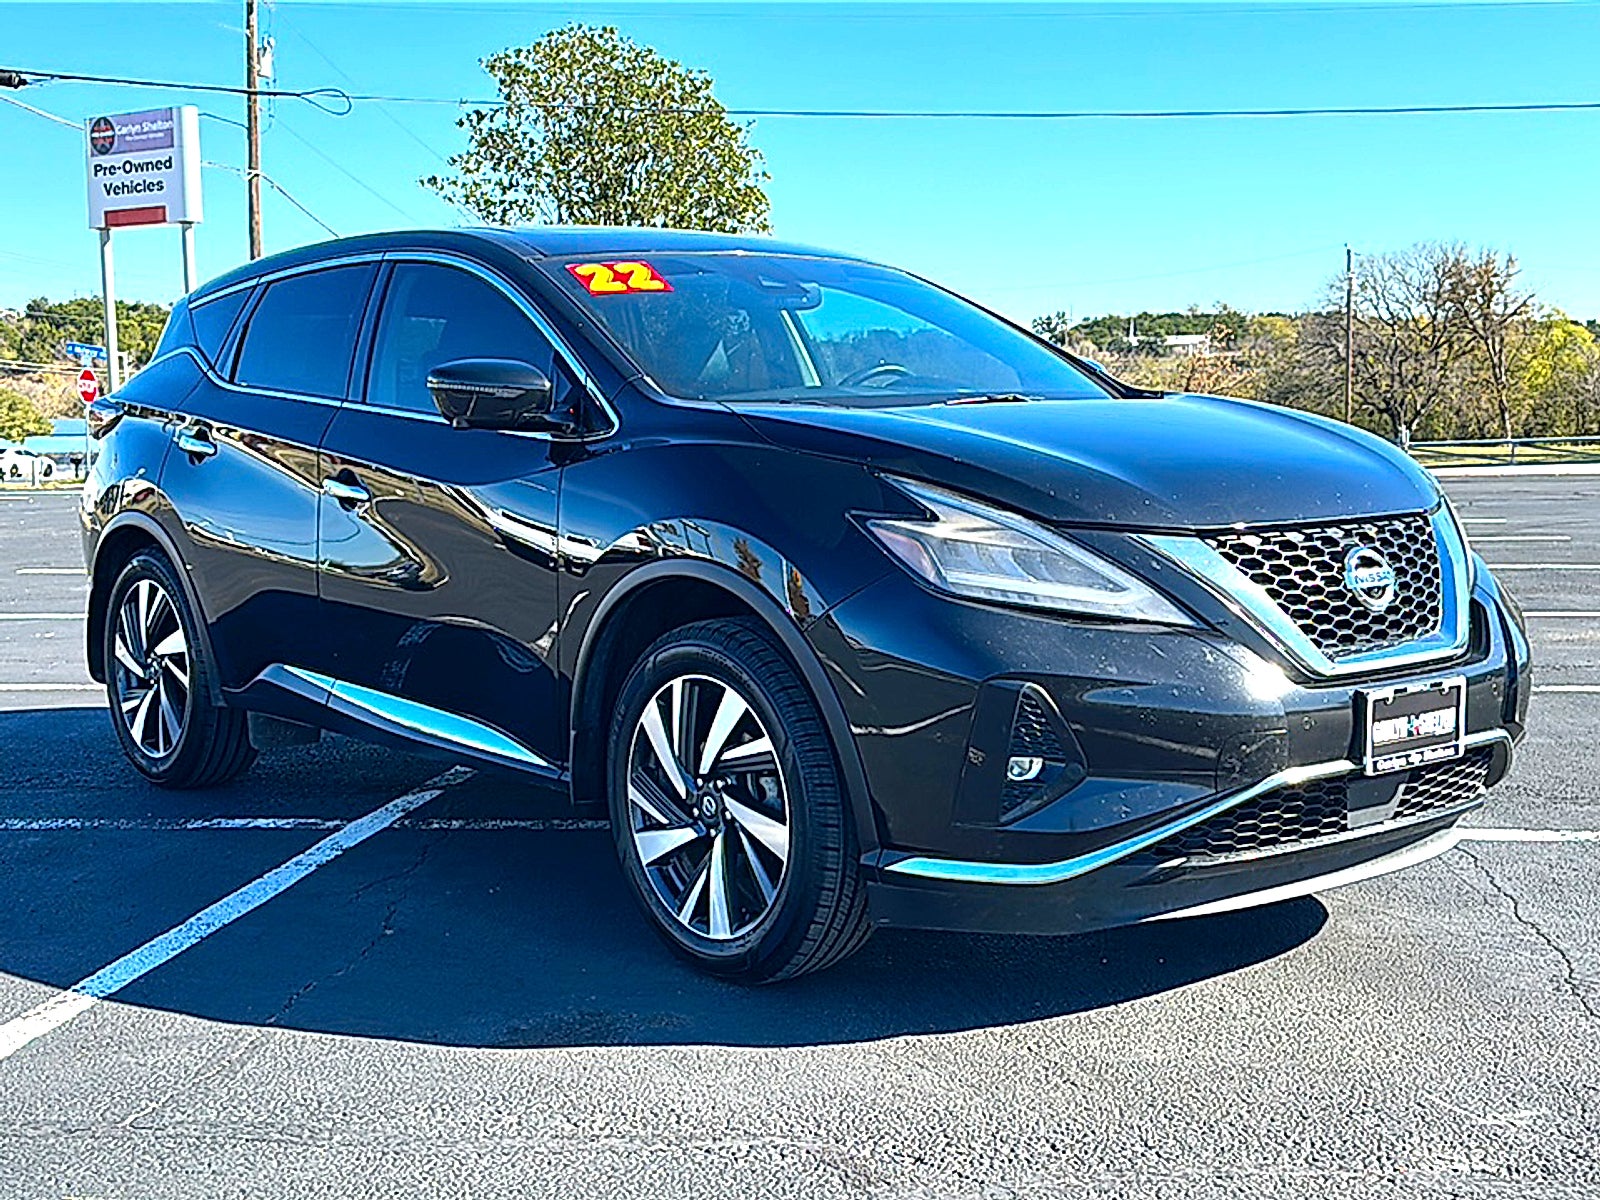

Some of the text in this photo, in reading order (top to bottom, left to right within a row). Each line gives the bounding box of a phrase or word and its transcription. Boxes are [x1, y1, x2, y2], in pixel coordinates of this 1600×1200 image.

[93, 156, 173, 177] Pre-Owned
[103, 180, 165, 196] Vehicles
[574, 262, 665, 292] 22
